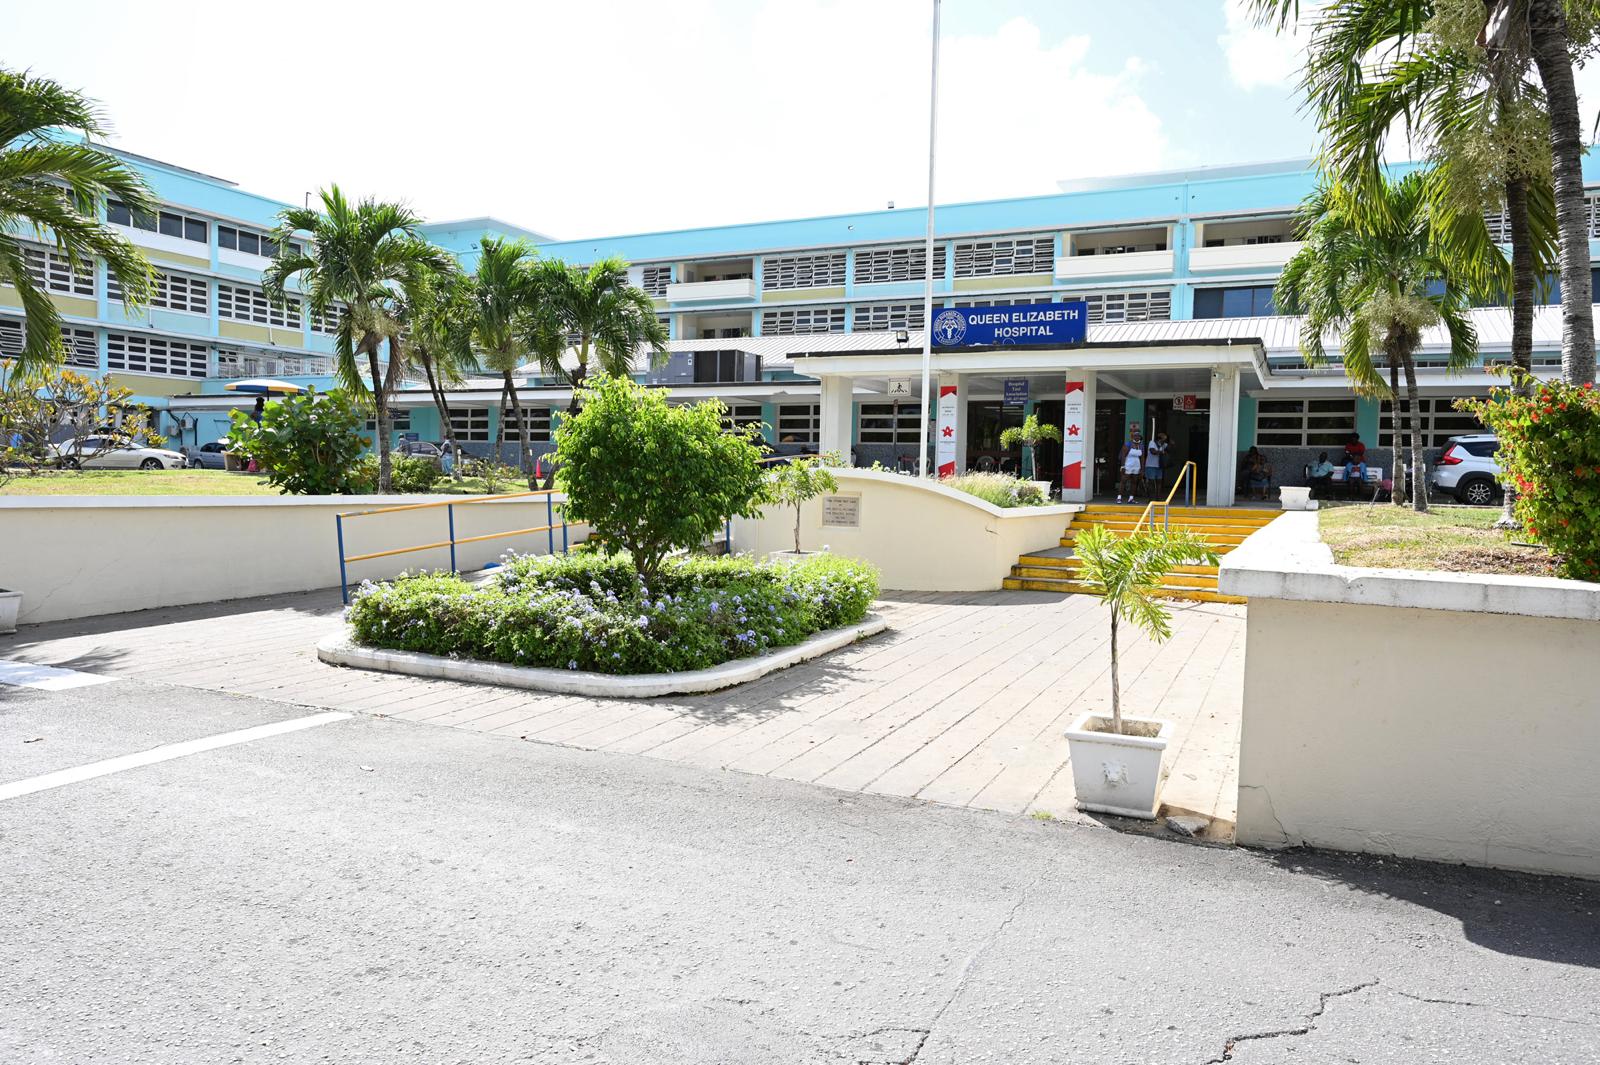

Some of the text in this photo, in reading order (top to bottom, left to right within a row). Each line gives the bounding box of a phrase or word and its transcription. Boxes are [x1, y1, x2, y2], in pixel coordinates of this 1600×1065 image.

[968, 309, 1079, 325] QUEEN ELIZABETH
[994, 325, 1054, 338] HOSPITAL
